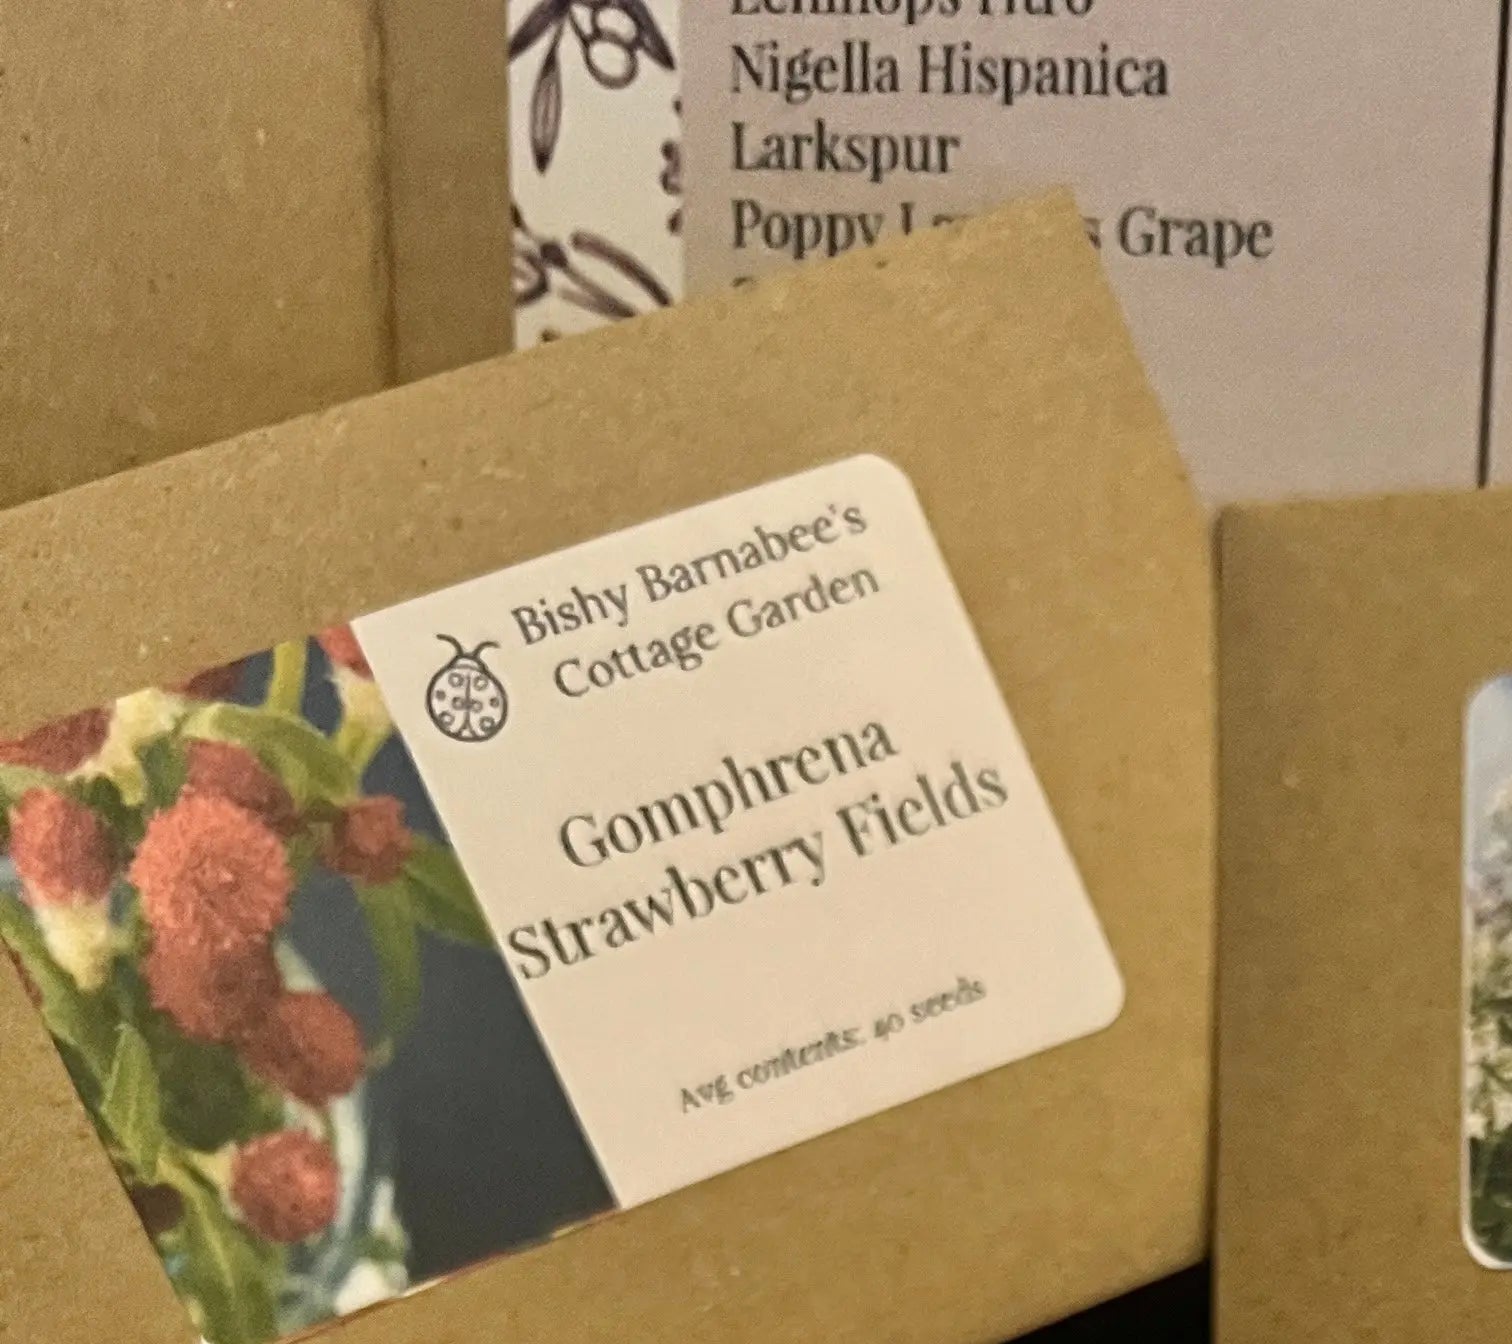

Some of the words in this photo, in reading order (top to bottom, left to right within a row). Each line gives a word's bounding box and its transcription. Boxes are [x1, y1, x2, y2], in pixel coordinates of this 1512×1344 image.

[732, 40, 900, 104] Nigella
[918, 41, 1169, 103] Hispanica
[731, 120, 961, 182] Larkspur
[1117, 205, 1275, 268] Grape
[511, 580, 630, 646] Bishy
[636, 502, 869, 603] Barnabee's
[554, 622, 719, 698] Cottage
[725, 566, 881, 642] Garden
[558, 720, 900, 868] Gomphrena
[506, 830, 829, 982] Strawberry
[837, 760, 1010, 860] Fields
[680, 1075, 734, 1113] Avg
